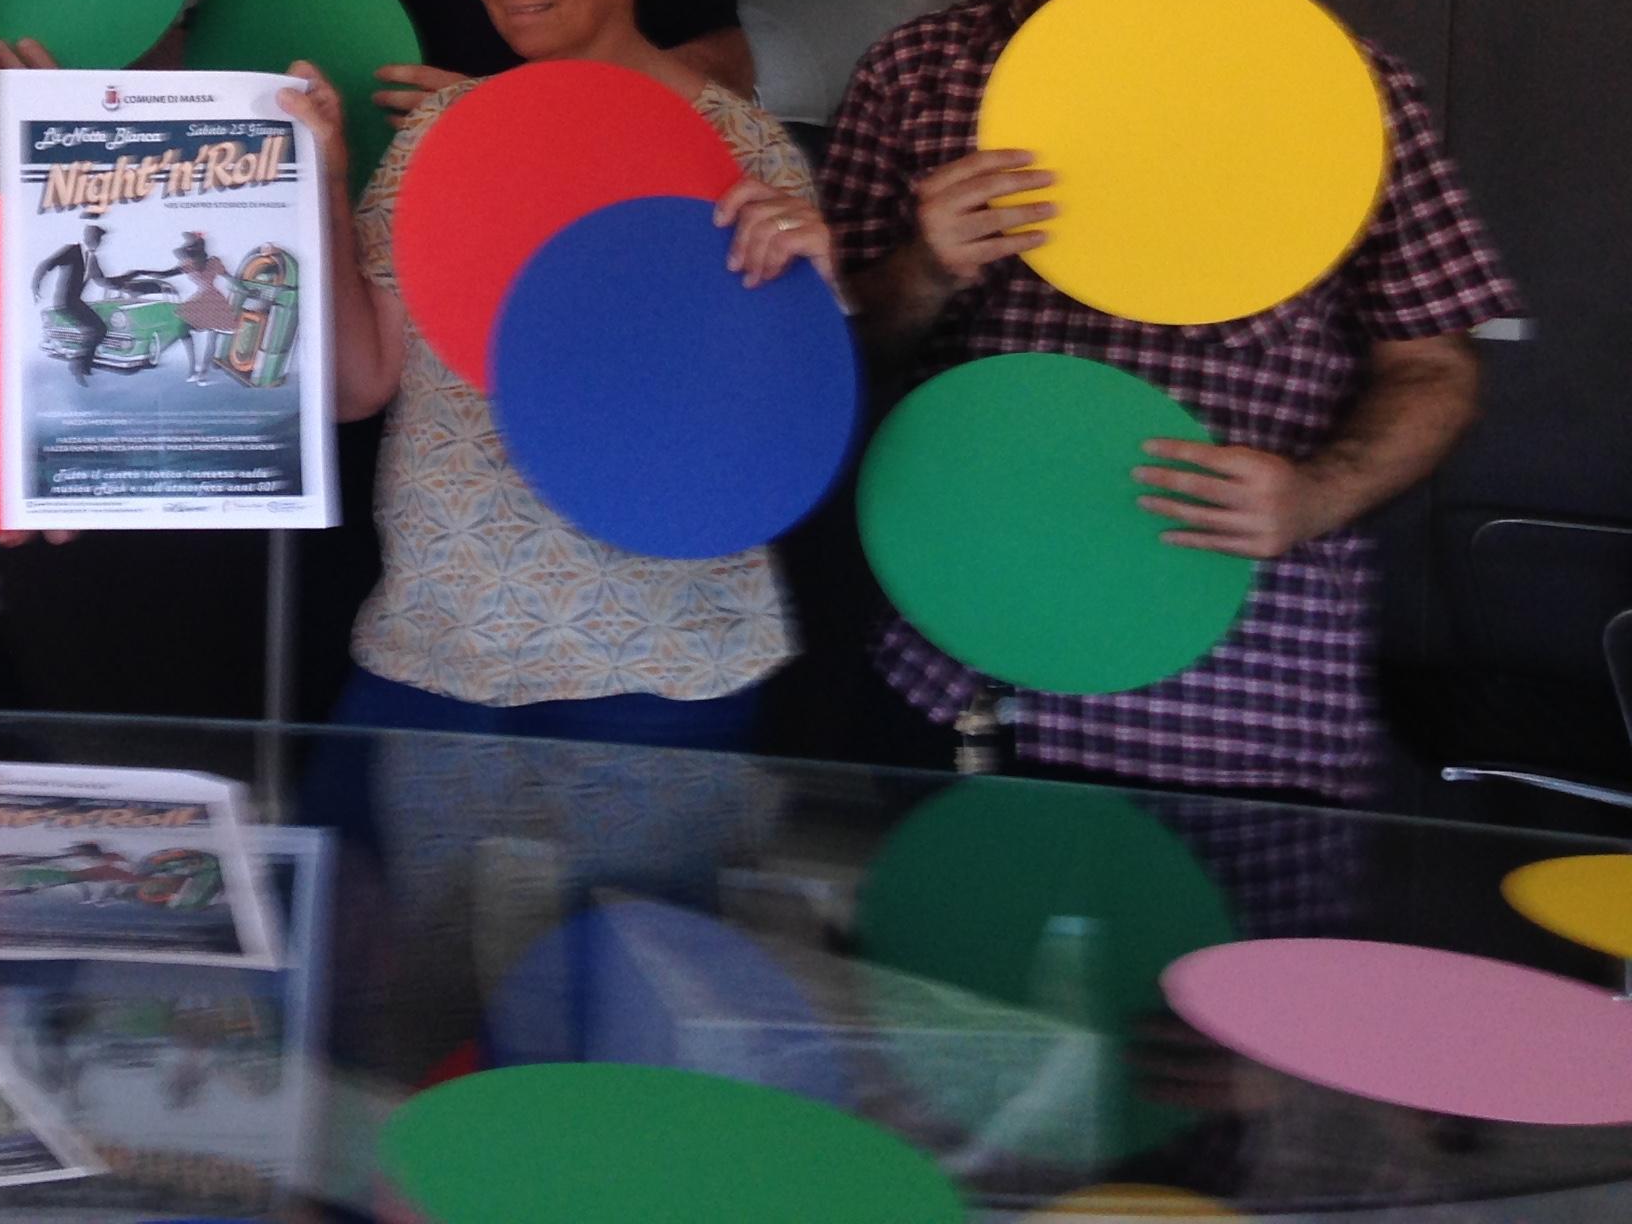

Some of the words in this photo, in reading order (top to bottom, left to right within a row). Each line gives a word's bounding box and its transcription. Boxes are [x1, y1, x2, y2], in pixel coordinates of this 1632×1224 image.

[123, 95, 166, 104] COMUNE
[168, 95, 178, 104] DI
[180, 95, 215, 104] MASSA
[186, 124, 227, 137] Sabato
[229, 124, 245, 135] 25
[61, 127, 107, 147] Notte
[105, 127, 165, 150] Bianca
